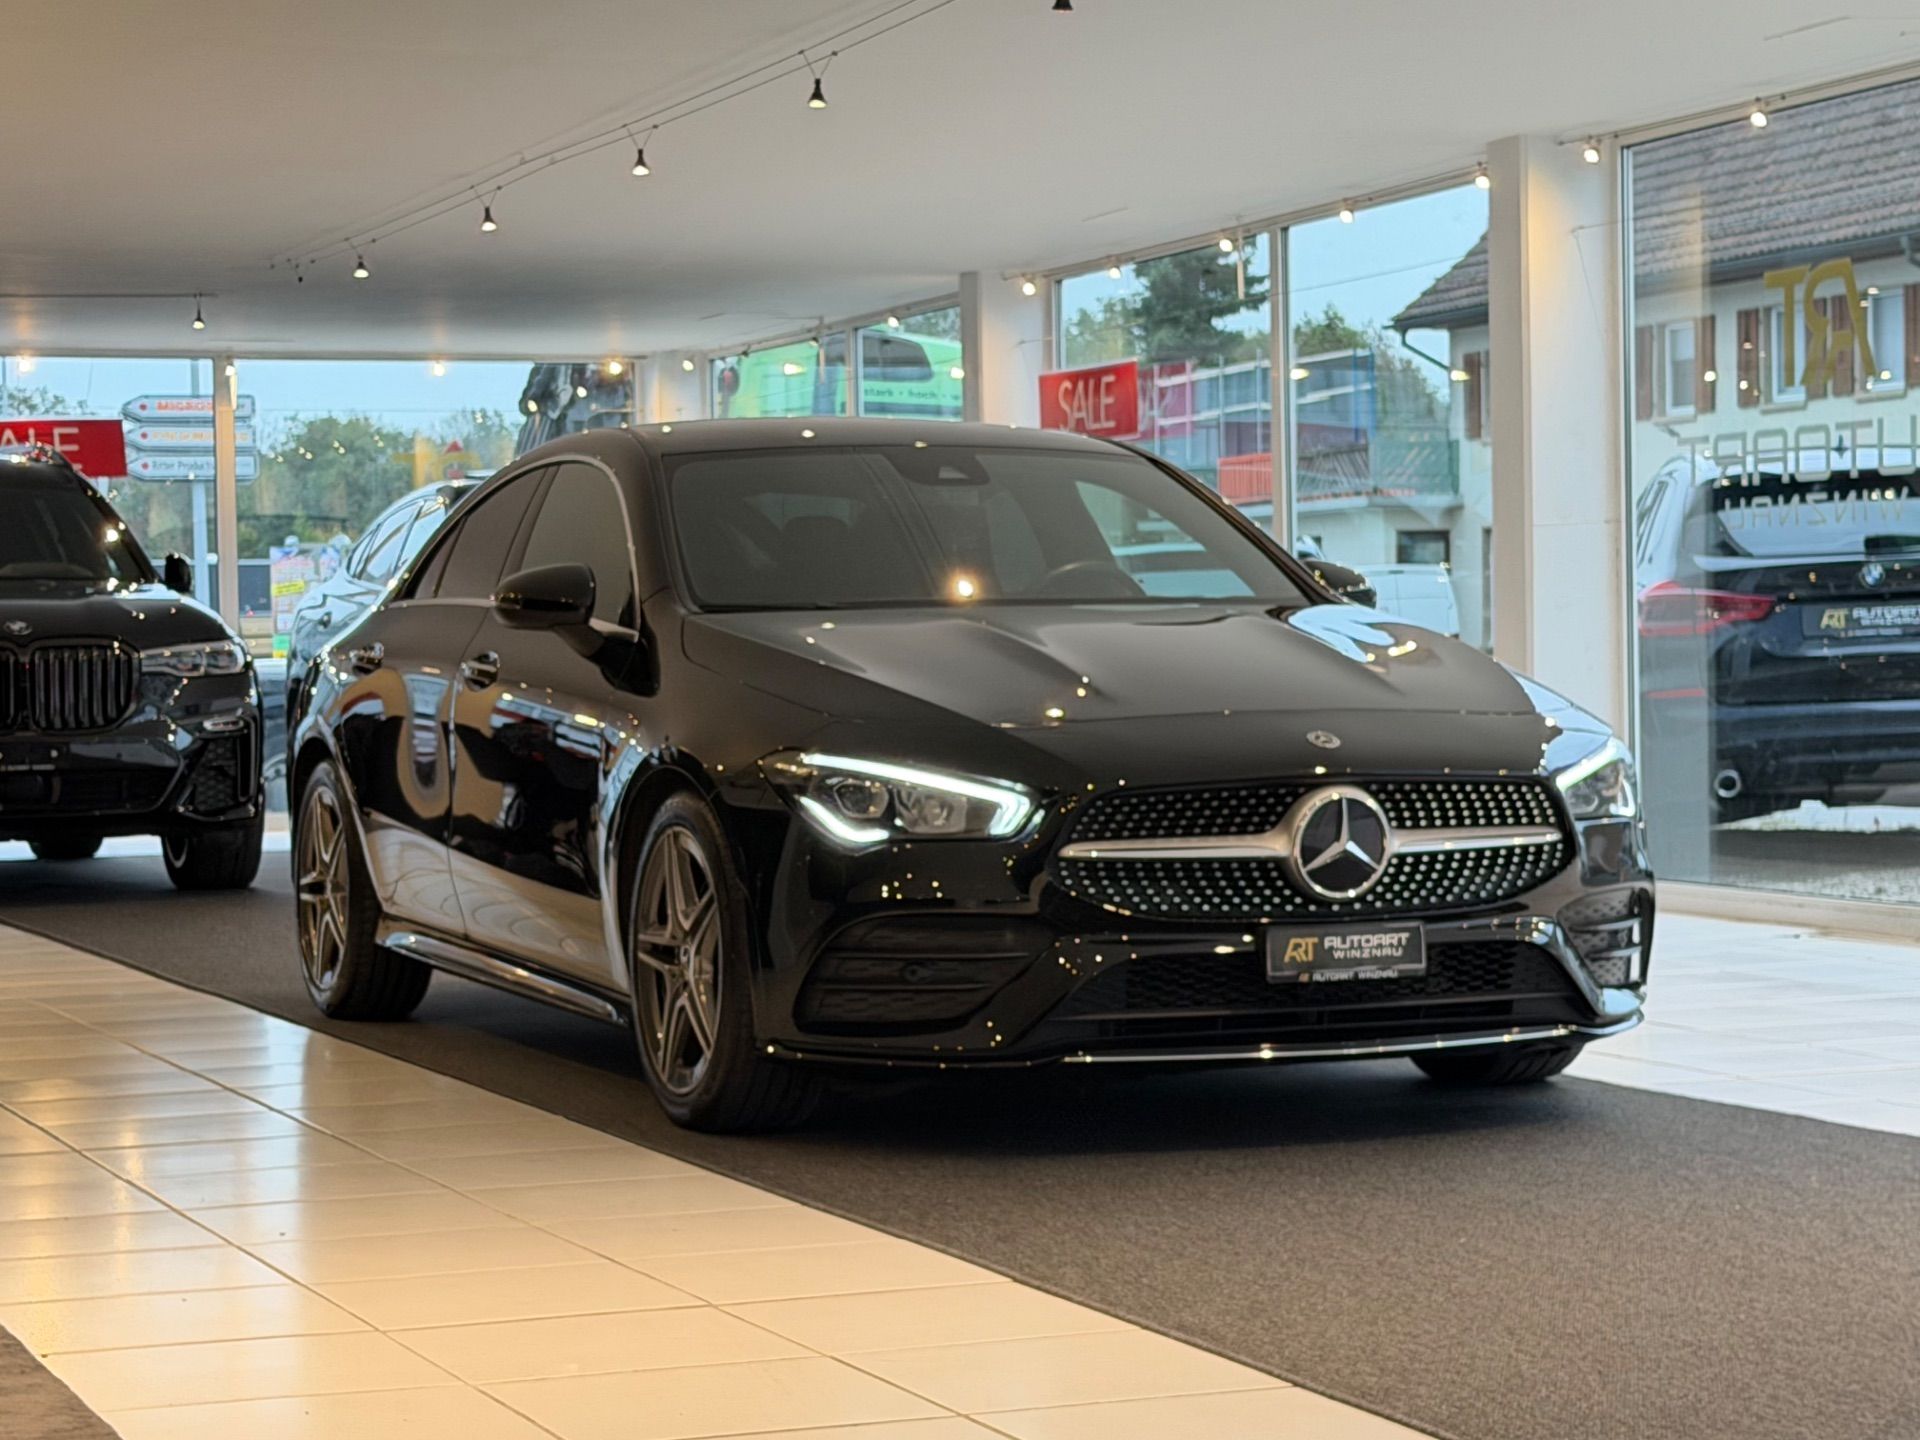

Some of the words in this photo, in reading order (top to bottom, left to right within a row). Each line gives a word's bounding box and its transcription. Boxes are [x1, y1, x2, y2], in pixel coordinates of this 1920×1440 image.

[1058, 373, 1117, 432] SALE
[1323, 932, 1411, 950] AUTOART
[1333, 946, 1404, 960] WINZNAU
